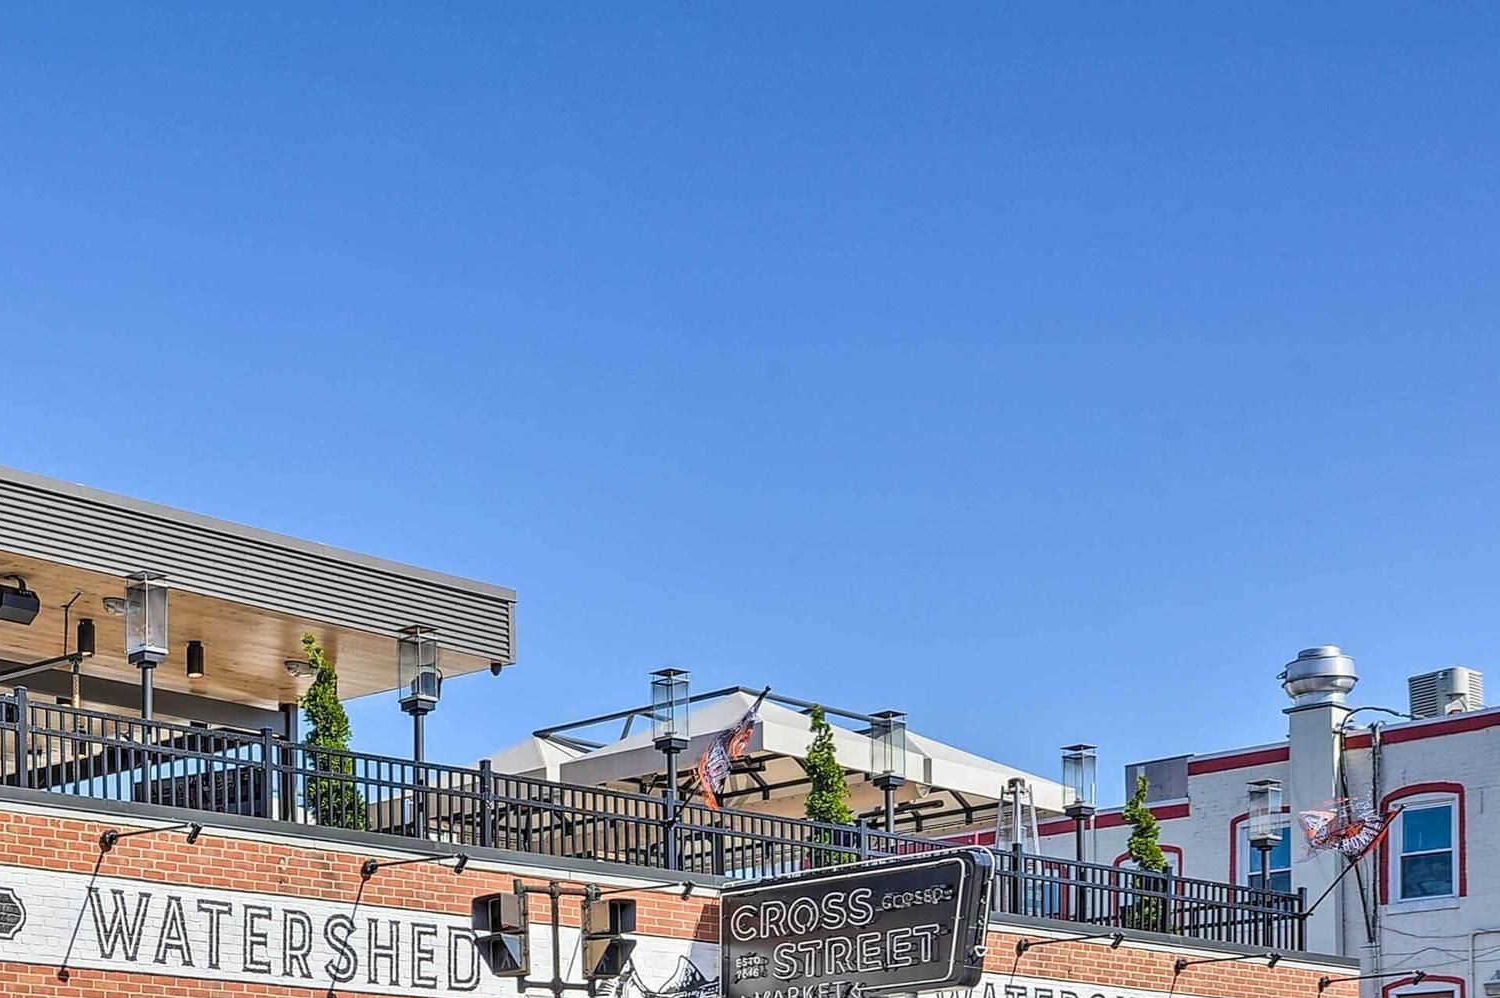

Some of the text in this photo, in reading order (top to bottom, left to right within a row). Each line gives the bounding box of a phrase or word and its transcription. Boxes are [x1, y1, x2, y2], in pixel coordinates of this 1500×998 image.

[89, 886, 481, 993] WATERSHED
[730, 888, 873, 942] CROSS
[773, 923, 940, 980] STREET
